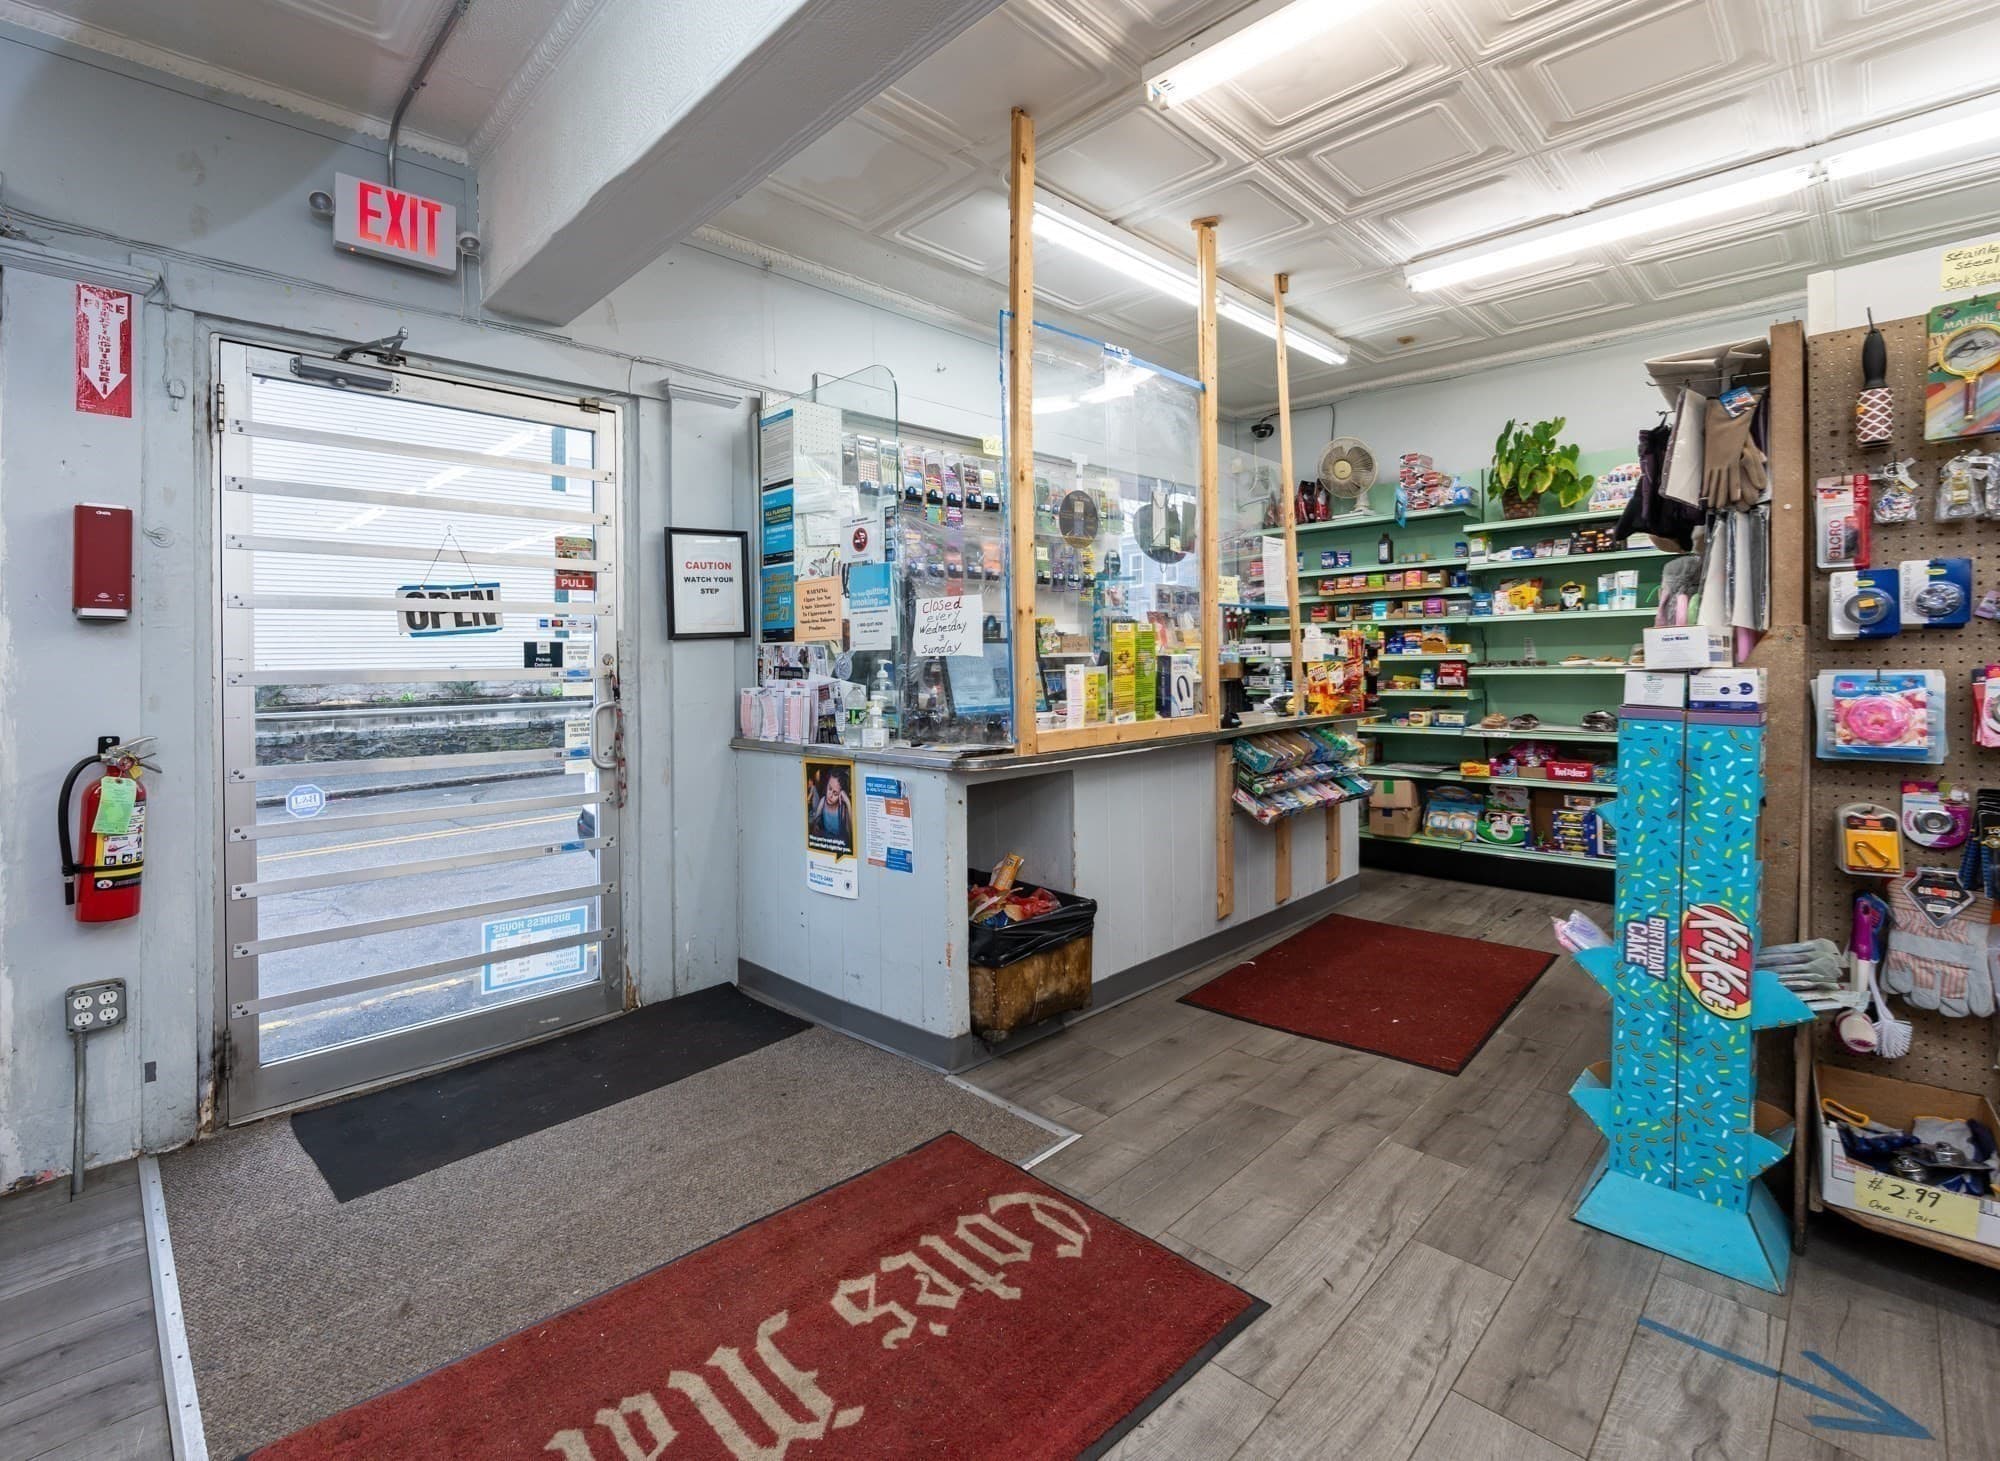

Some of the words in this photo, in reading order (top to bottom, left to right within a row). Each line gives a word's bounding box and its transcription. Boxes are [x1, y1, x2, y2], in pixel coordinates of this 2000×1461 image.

[359, 181, 442, 257] EXIT
[1828, 519, 1842, 561] ELCRO
[561, 578, 588, 588] PULL
[685, 561, 732, 570] CAUTION
[405, 590, 497, 630] OPEN
[920, 621, 967, 635] Wednesday
[927, 611, 960, 624] every
[921, 640, 961, 655] Sunday
[1626, 922, 1648, 967] CAKE
[1649, 917, 1666, 979] BIRTHDAY
[1868, 1199, 1896, 1215] One
[1905, 1208, 1938, 1225] Pair
[830, 1191, 1091, 1350] Cote's
[543, 1309, 865, 1461] Ma
